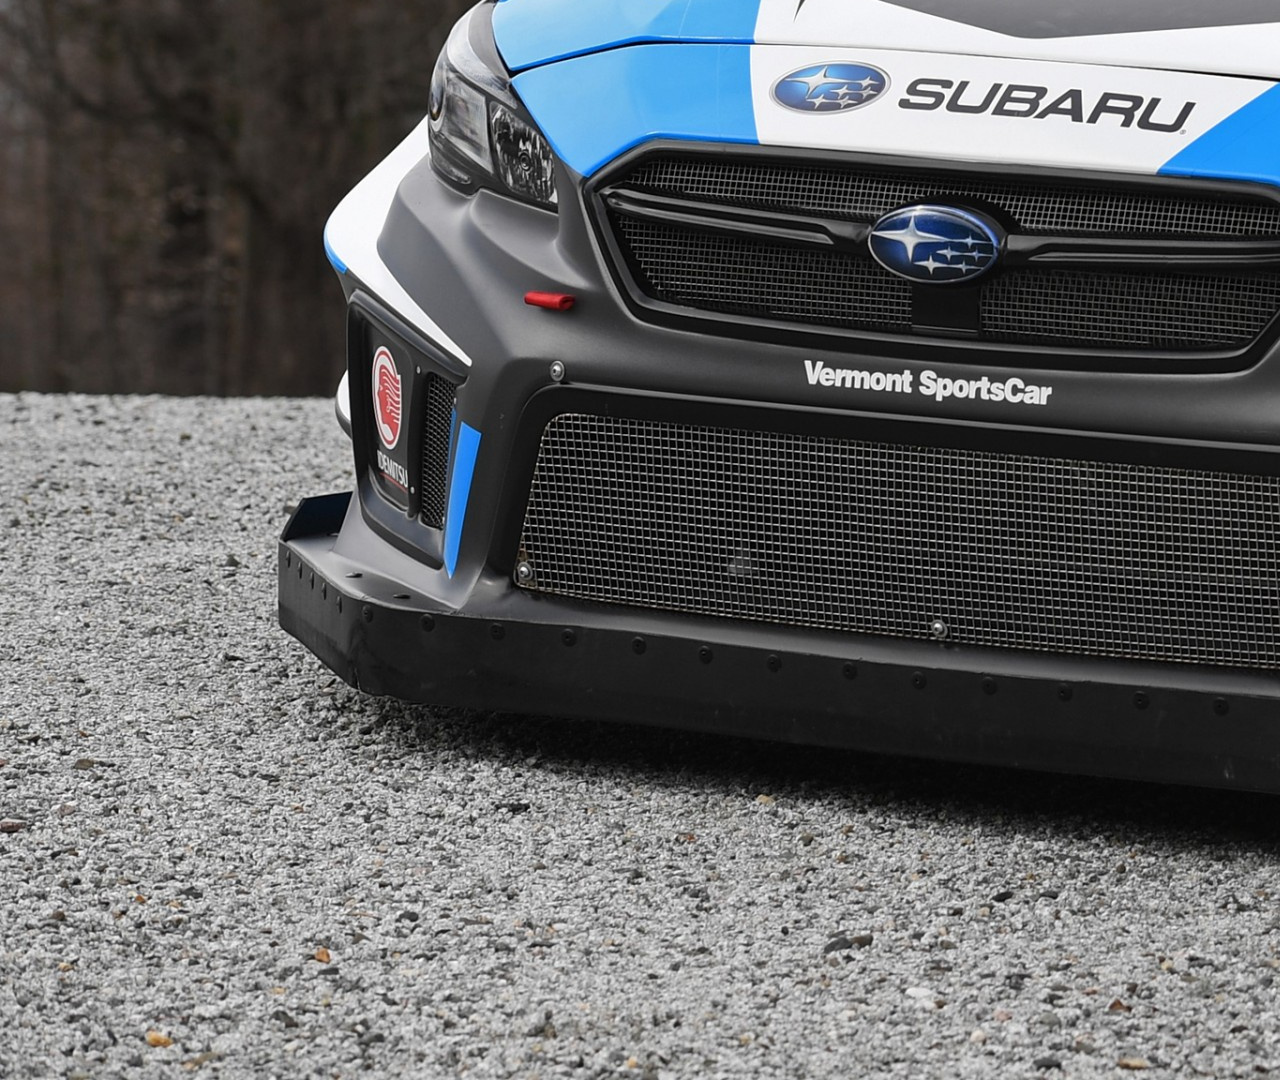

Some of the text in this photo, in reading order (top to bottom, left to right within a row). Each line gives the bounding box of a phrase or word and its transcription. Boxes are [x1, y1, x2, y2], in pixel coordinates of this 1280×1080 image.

[898, 77, 1197, 135] SUBARU
[804, 360, 1052, 405] Vermont SportsCar
[377, 449, 409, 488] IDEMITSU
